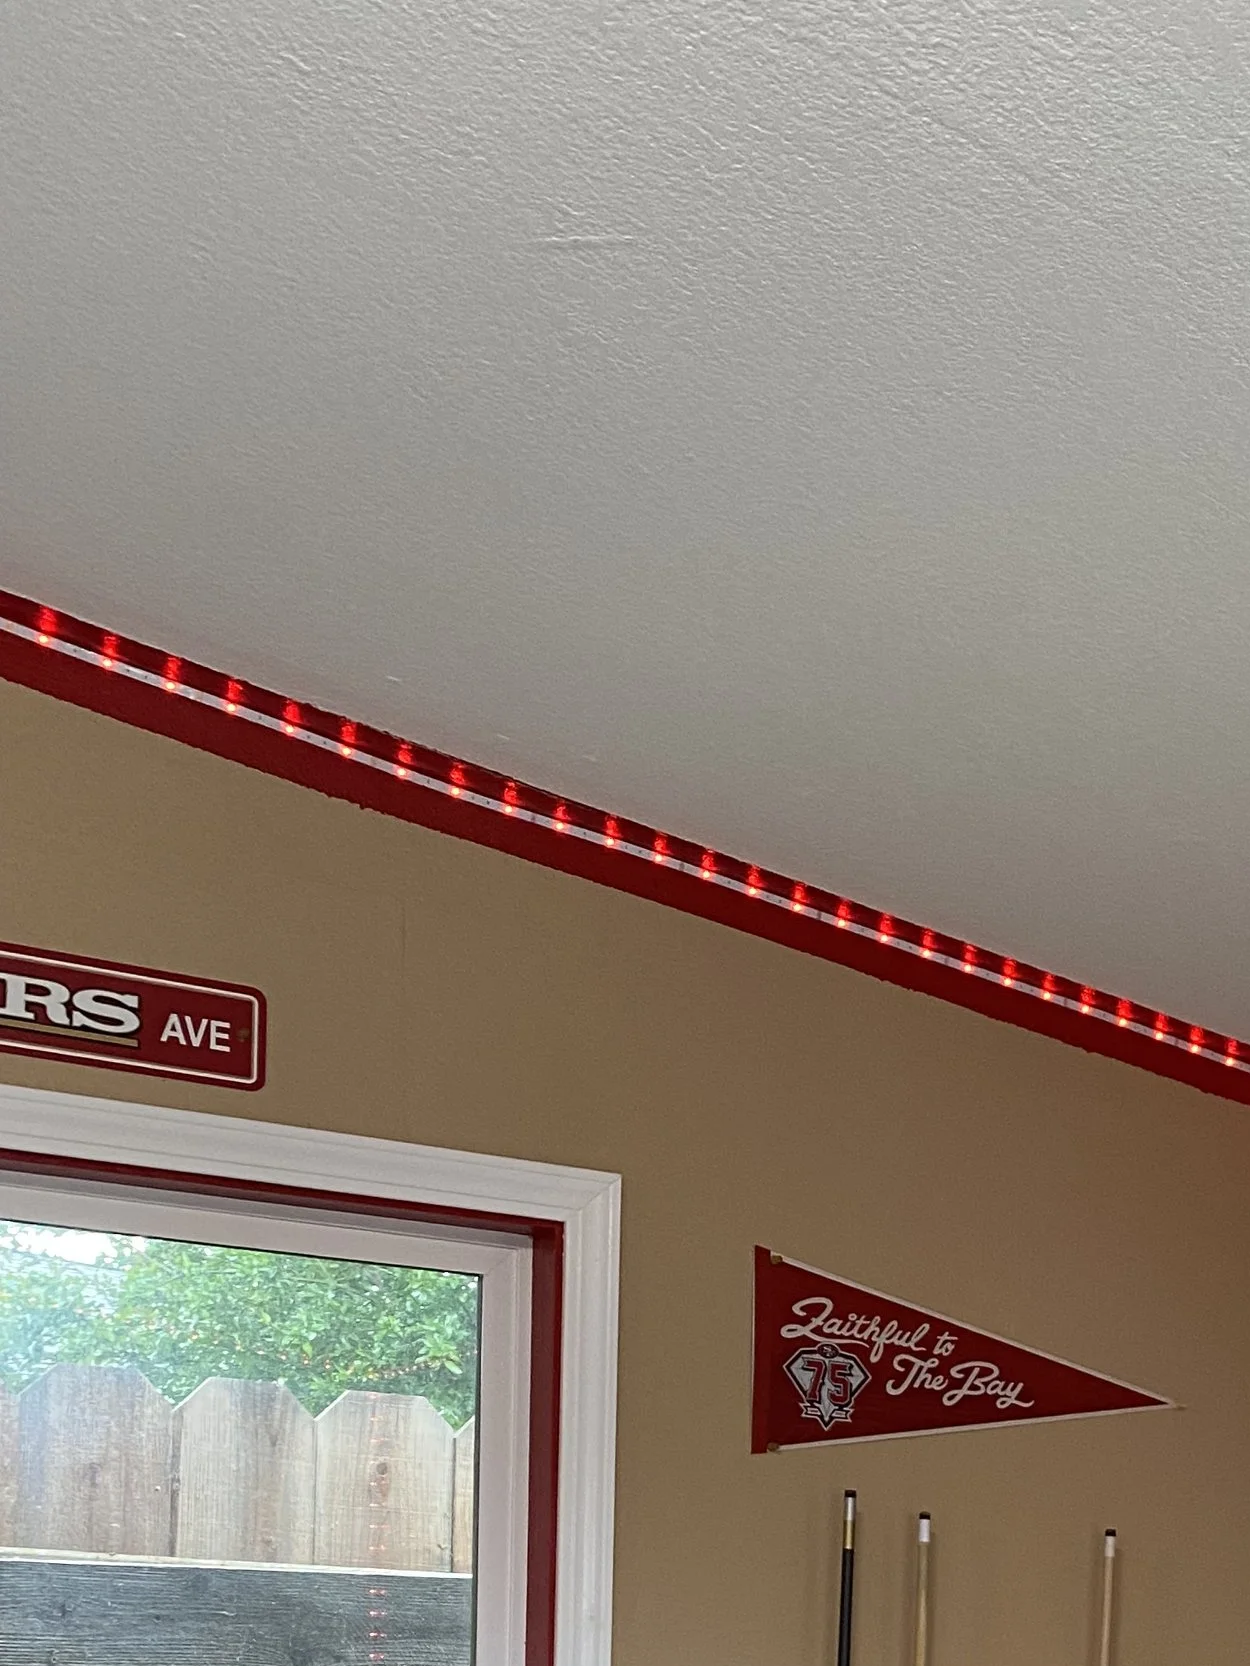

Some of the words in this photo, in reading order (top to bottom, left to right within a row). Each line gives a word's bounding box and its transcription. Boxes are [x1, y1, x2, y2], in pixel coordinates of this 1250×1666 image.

[160, 1013, 231, 1052] AVE
[780, 1296, 930, 1363] Faithful
[933, 1331, 958, 1356] to
[802, 1357, 854, 1406] 75
[885, 1353, 949, 1396] The
[942, 1360, 1035, 1409] Bay
